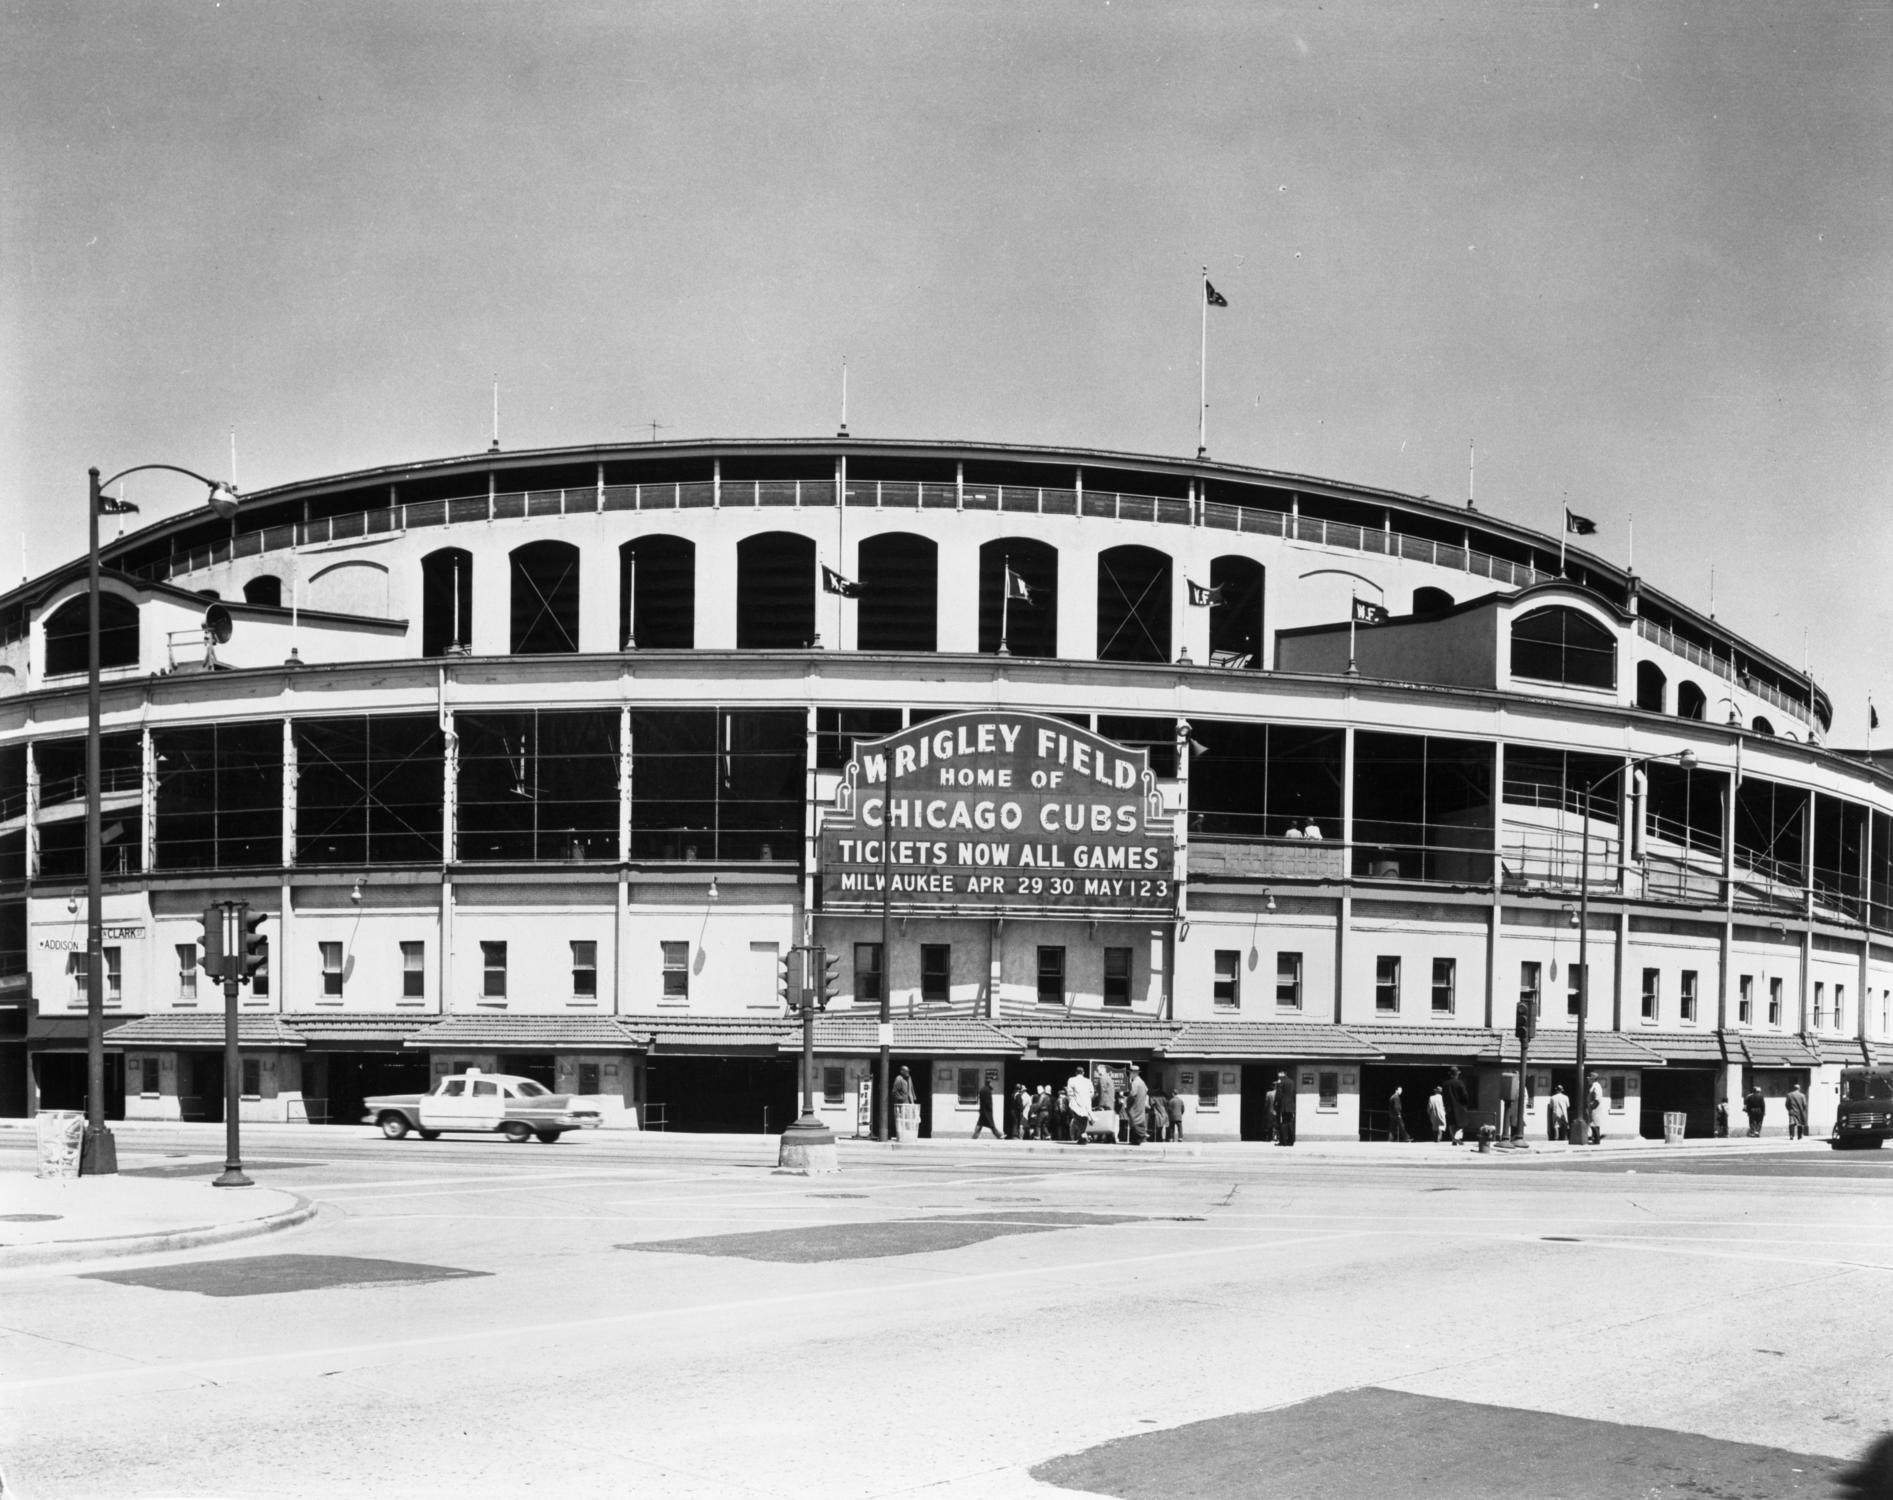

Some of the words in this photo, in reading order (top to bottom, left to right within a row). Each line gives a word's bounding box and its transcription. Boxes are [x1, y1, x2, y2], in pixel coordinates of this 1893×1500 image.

[863, 724, 1021, 784] WRIGLEY
[1038, 729, 1137, 789] FIELD
[940, 768, 1012, 787] HOME
[1031, 771, 1064, 789] OF
[862, 798, 1023, 829] CHICAGO
[1039, 803, 1137, 833] CUBS
[839, 840, 947, 865] TICKETS
[958, 843, 1010, 866] NOW
[1018, 844, 1065, 867] ALL
[1073, 846, 1158, 870] GAMES
[841, 874, 954, 892] MILWAUKEE
[967, 876, 1004, 893] APR
[1018, 877, 1043, 894] 29
[1050, 878, 1074, 895] 30
[1084, 879, 1123, 896] MAY
[1140, 881, 1151, 897] 2
[1156, 881, 1168, 897] 3
[45, 939, 79, 951] ADDISON
[107, 928, 136, 939] CLARK
